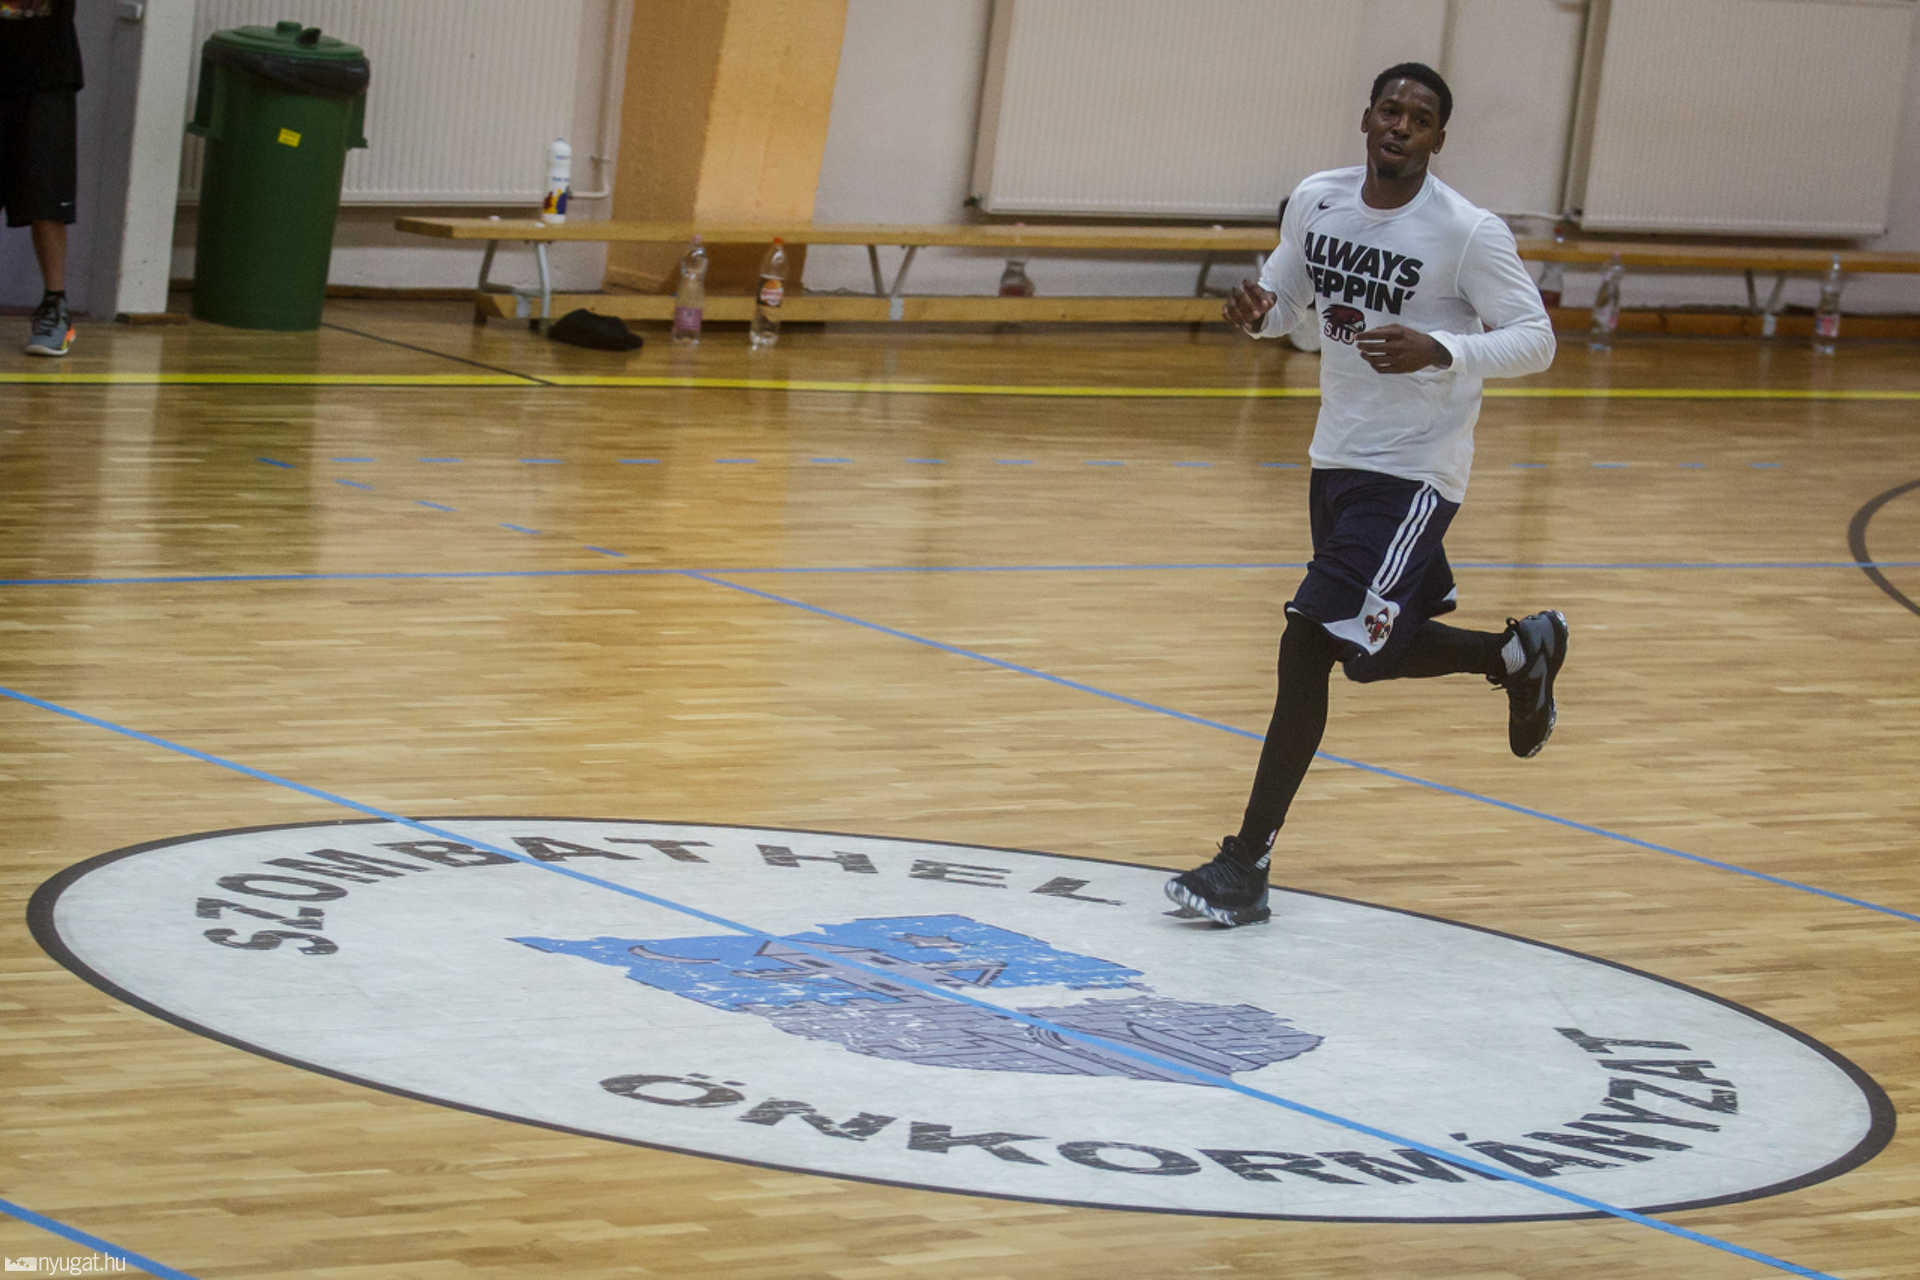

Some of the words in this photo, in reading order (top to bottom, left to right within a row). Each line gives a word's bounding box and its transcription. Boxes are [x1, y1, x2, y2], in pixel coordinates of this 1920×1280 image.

[1305, 231, 1424, 287] ALWAYS
[1306, 263, 1416, 315] EPPIN'
[1323, 321, 1359, 345] SJU
[599, 1027, 1739, 1185] ÖNKORMÁNYZAT
